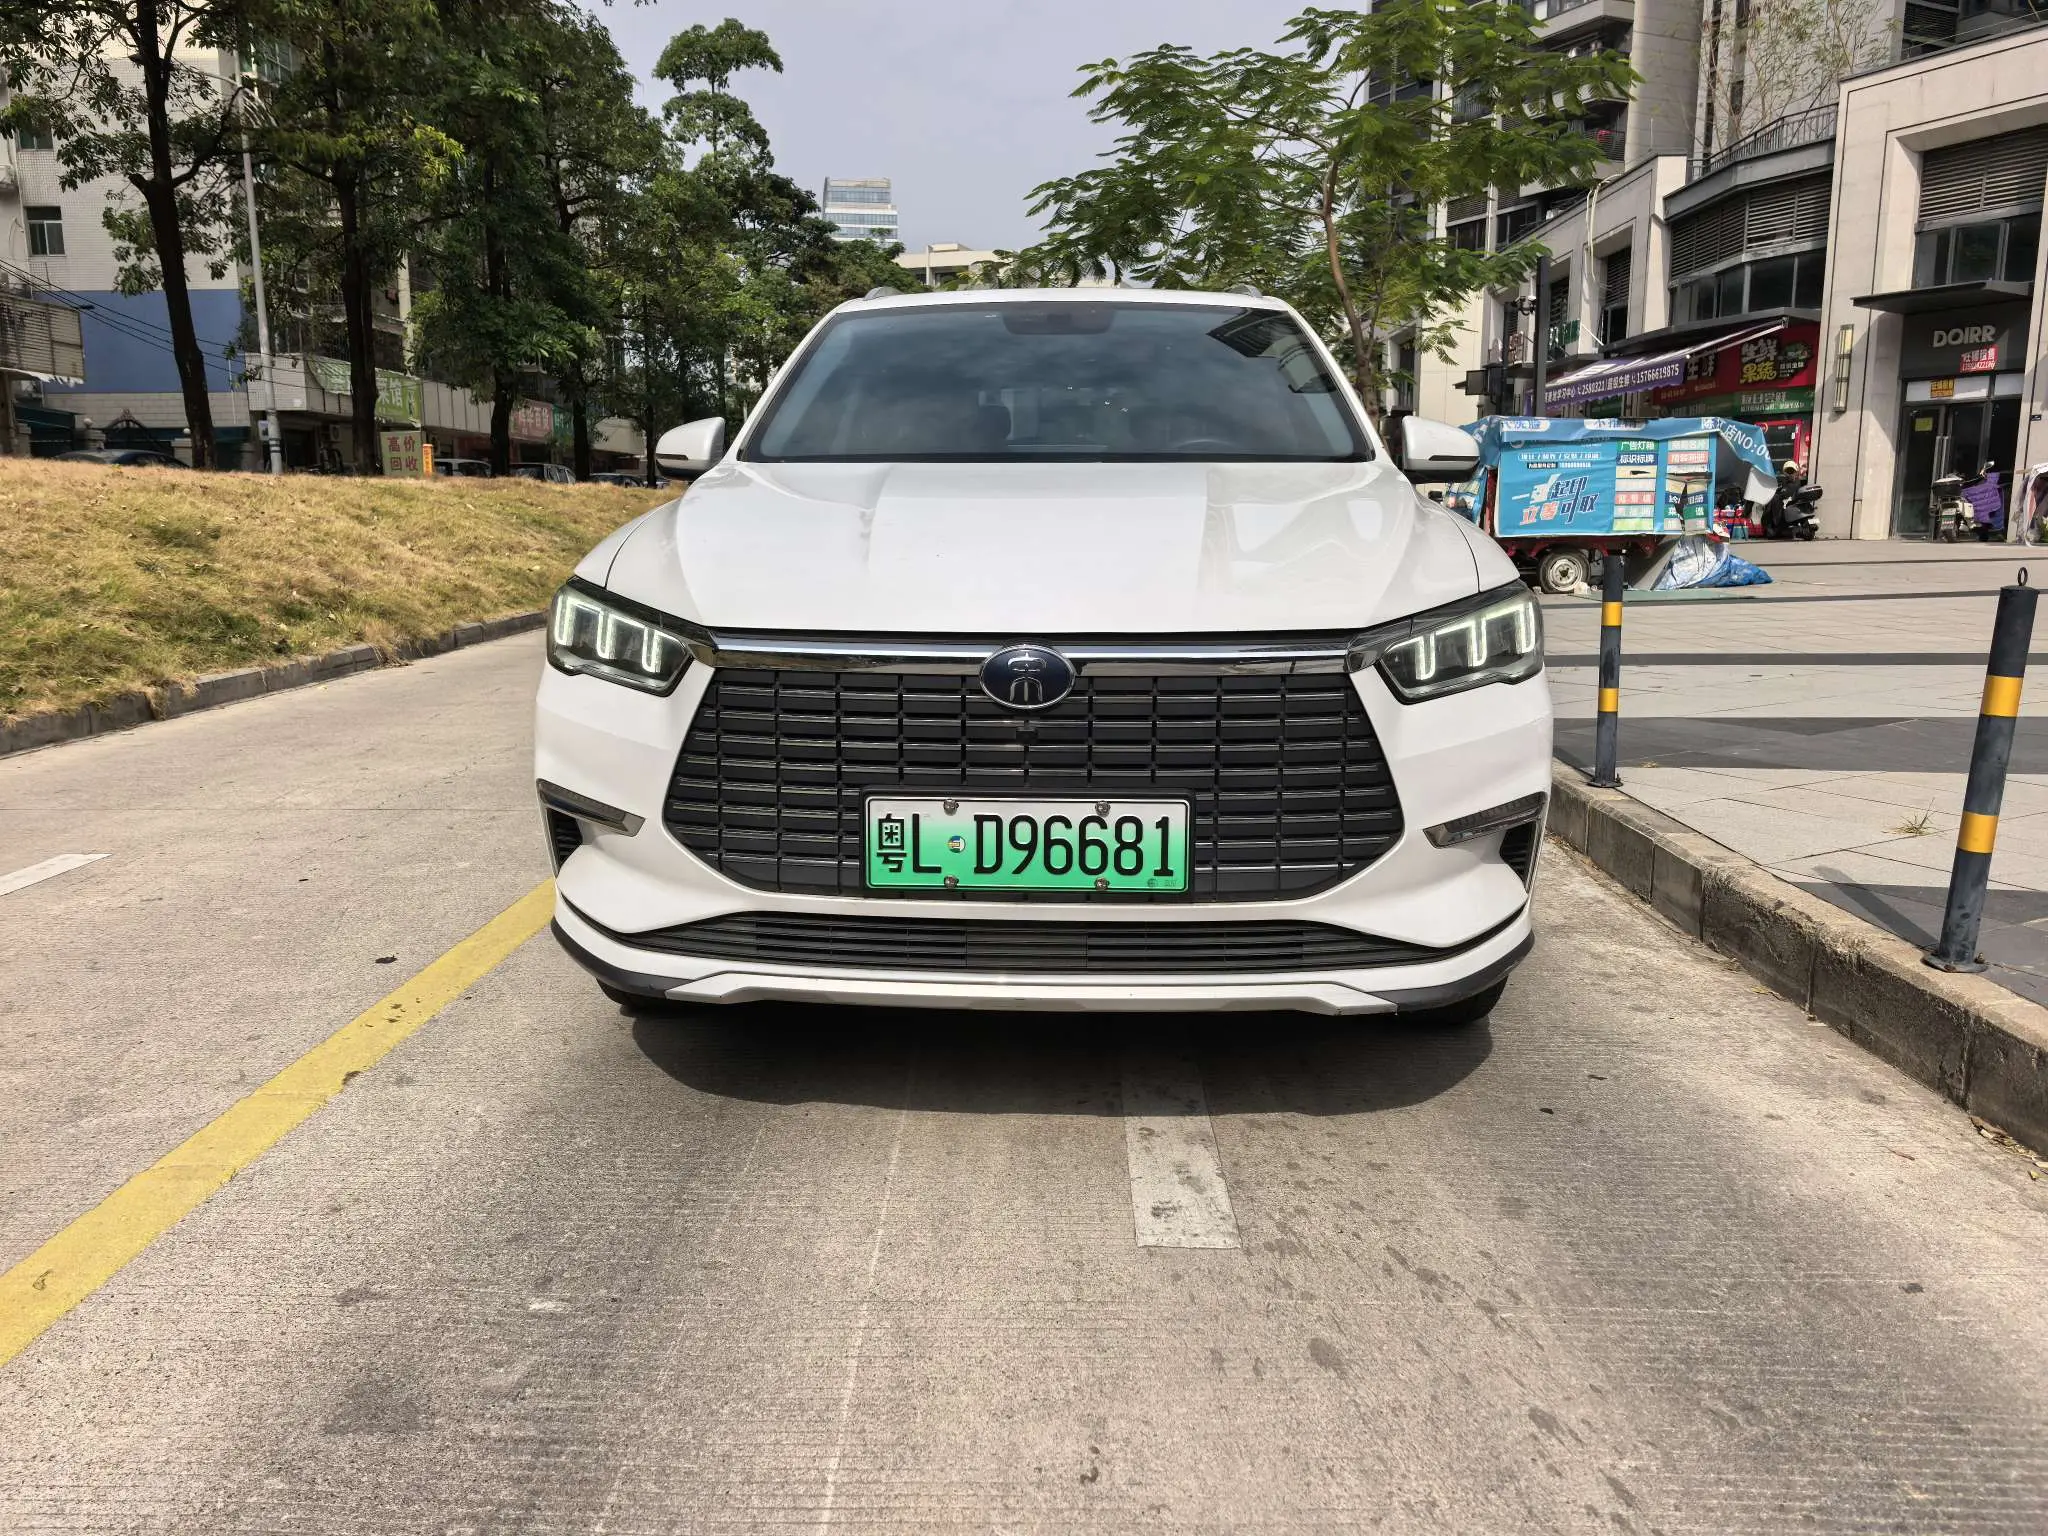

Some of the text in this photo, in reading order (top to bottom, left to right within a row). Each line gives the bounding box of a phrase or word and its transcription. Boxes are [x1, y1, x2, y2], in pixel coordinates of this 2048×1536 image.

[1933, 325, 1996, 348] DOIRR
[1741, 338, 1777, 363] 生鲜
[1739, 361, 1777, 384] 果蔬
[388, 436, 415, 452] 高价
[390, 456, 418, 472] 回收
[1520, 493, 1599, 524] 立等可取
[876, 813, 1175, 876] 粤L D96681
